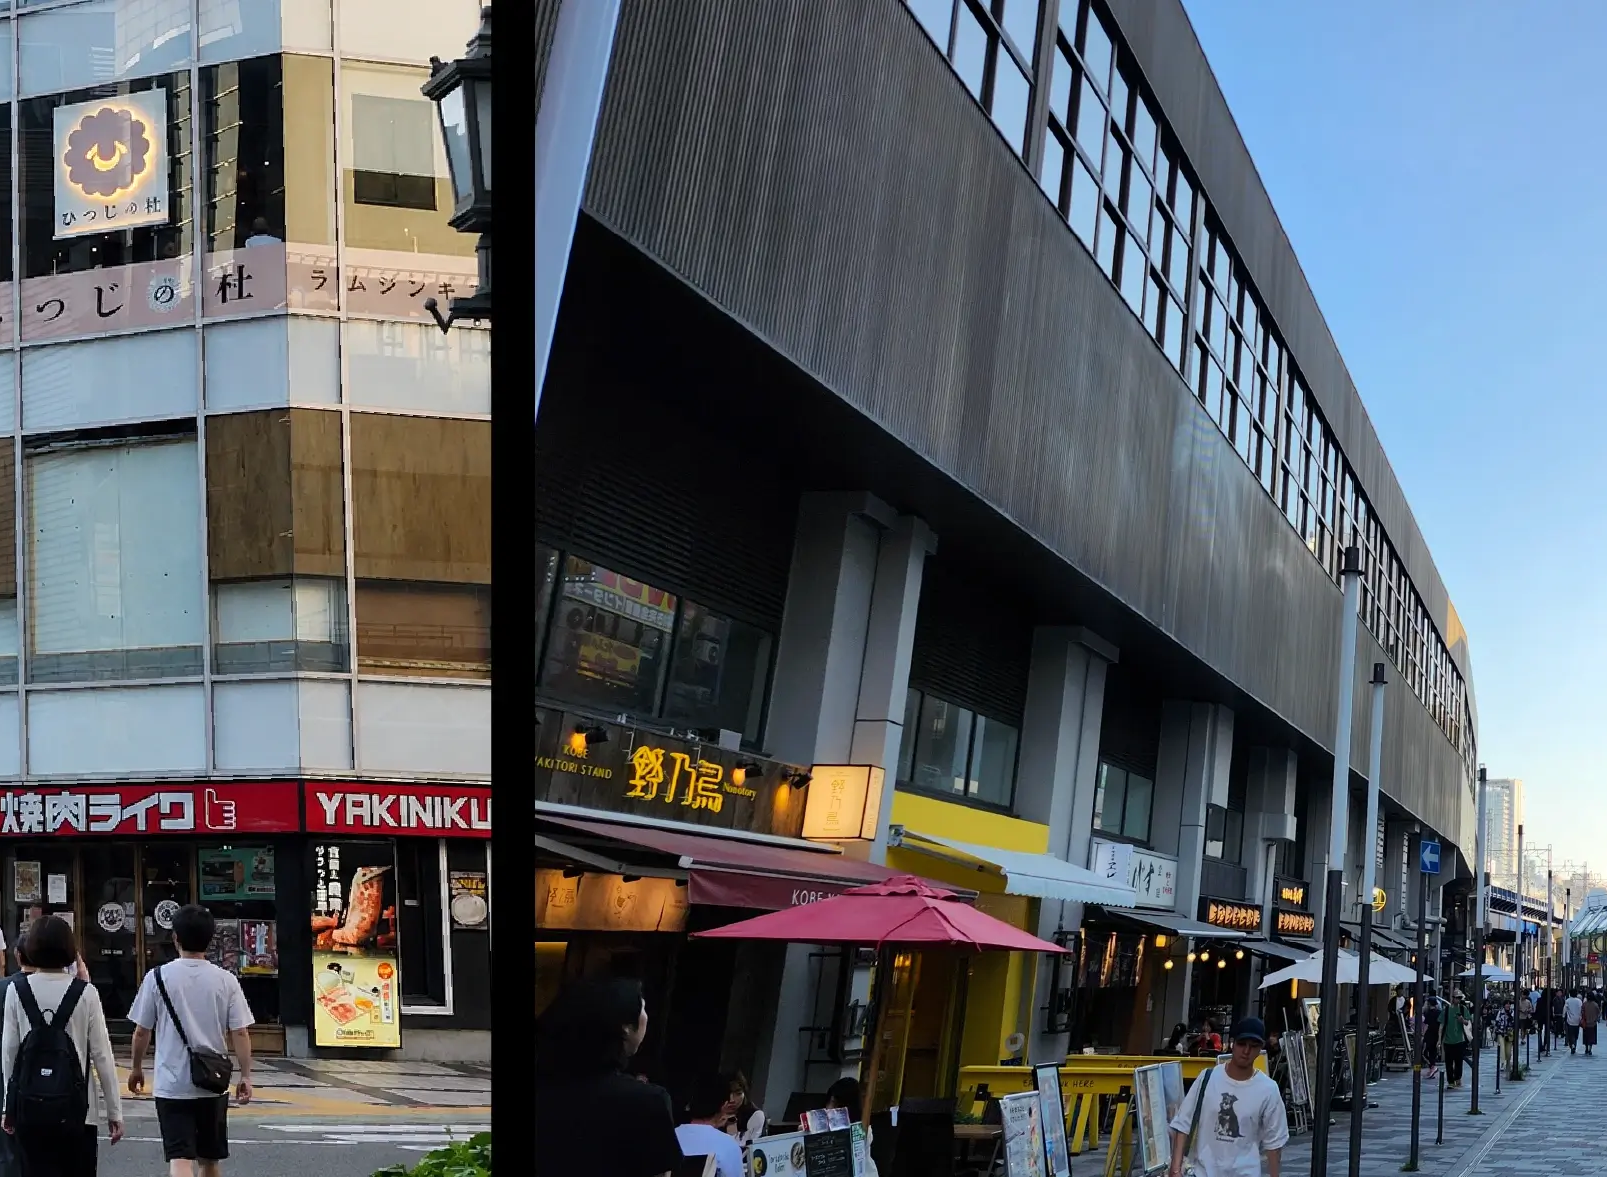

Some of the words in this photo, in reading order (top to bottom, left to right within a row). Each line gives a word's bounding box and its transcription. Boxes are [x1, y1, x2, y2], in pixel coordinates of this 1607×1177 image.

[62, 196, 161, 226] ひつじの杜
[310, 269, 479, 300] ラムジンキ
[580, 764, 613, 780] STAND
[0, 791, 195, 834] 焼肉ライク
[1073, 1079, 1095, 1088] HERE
